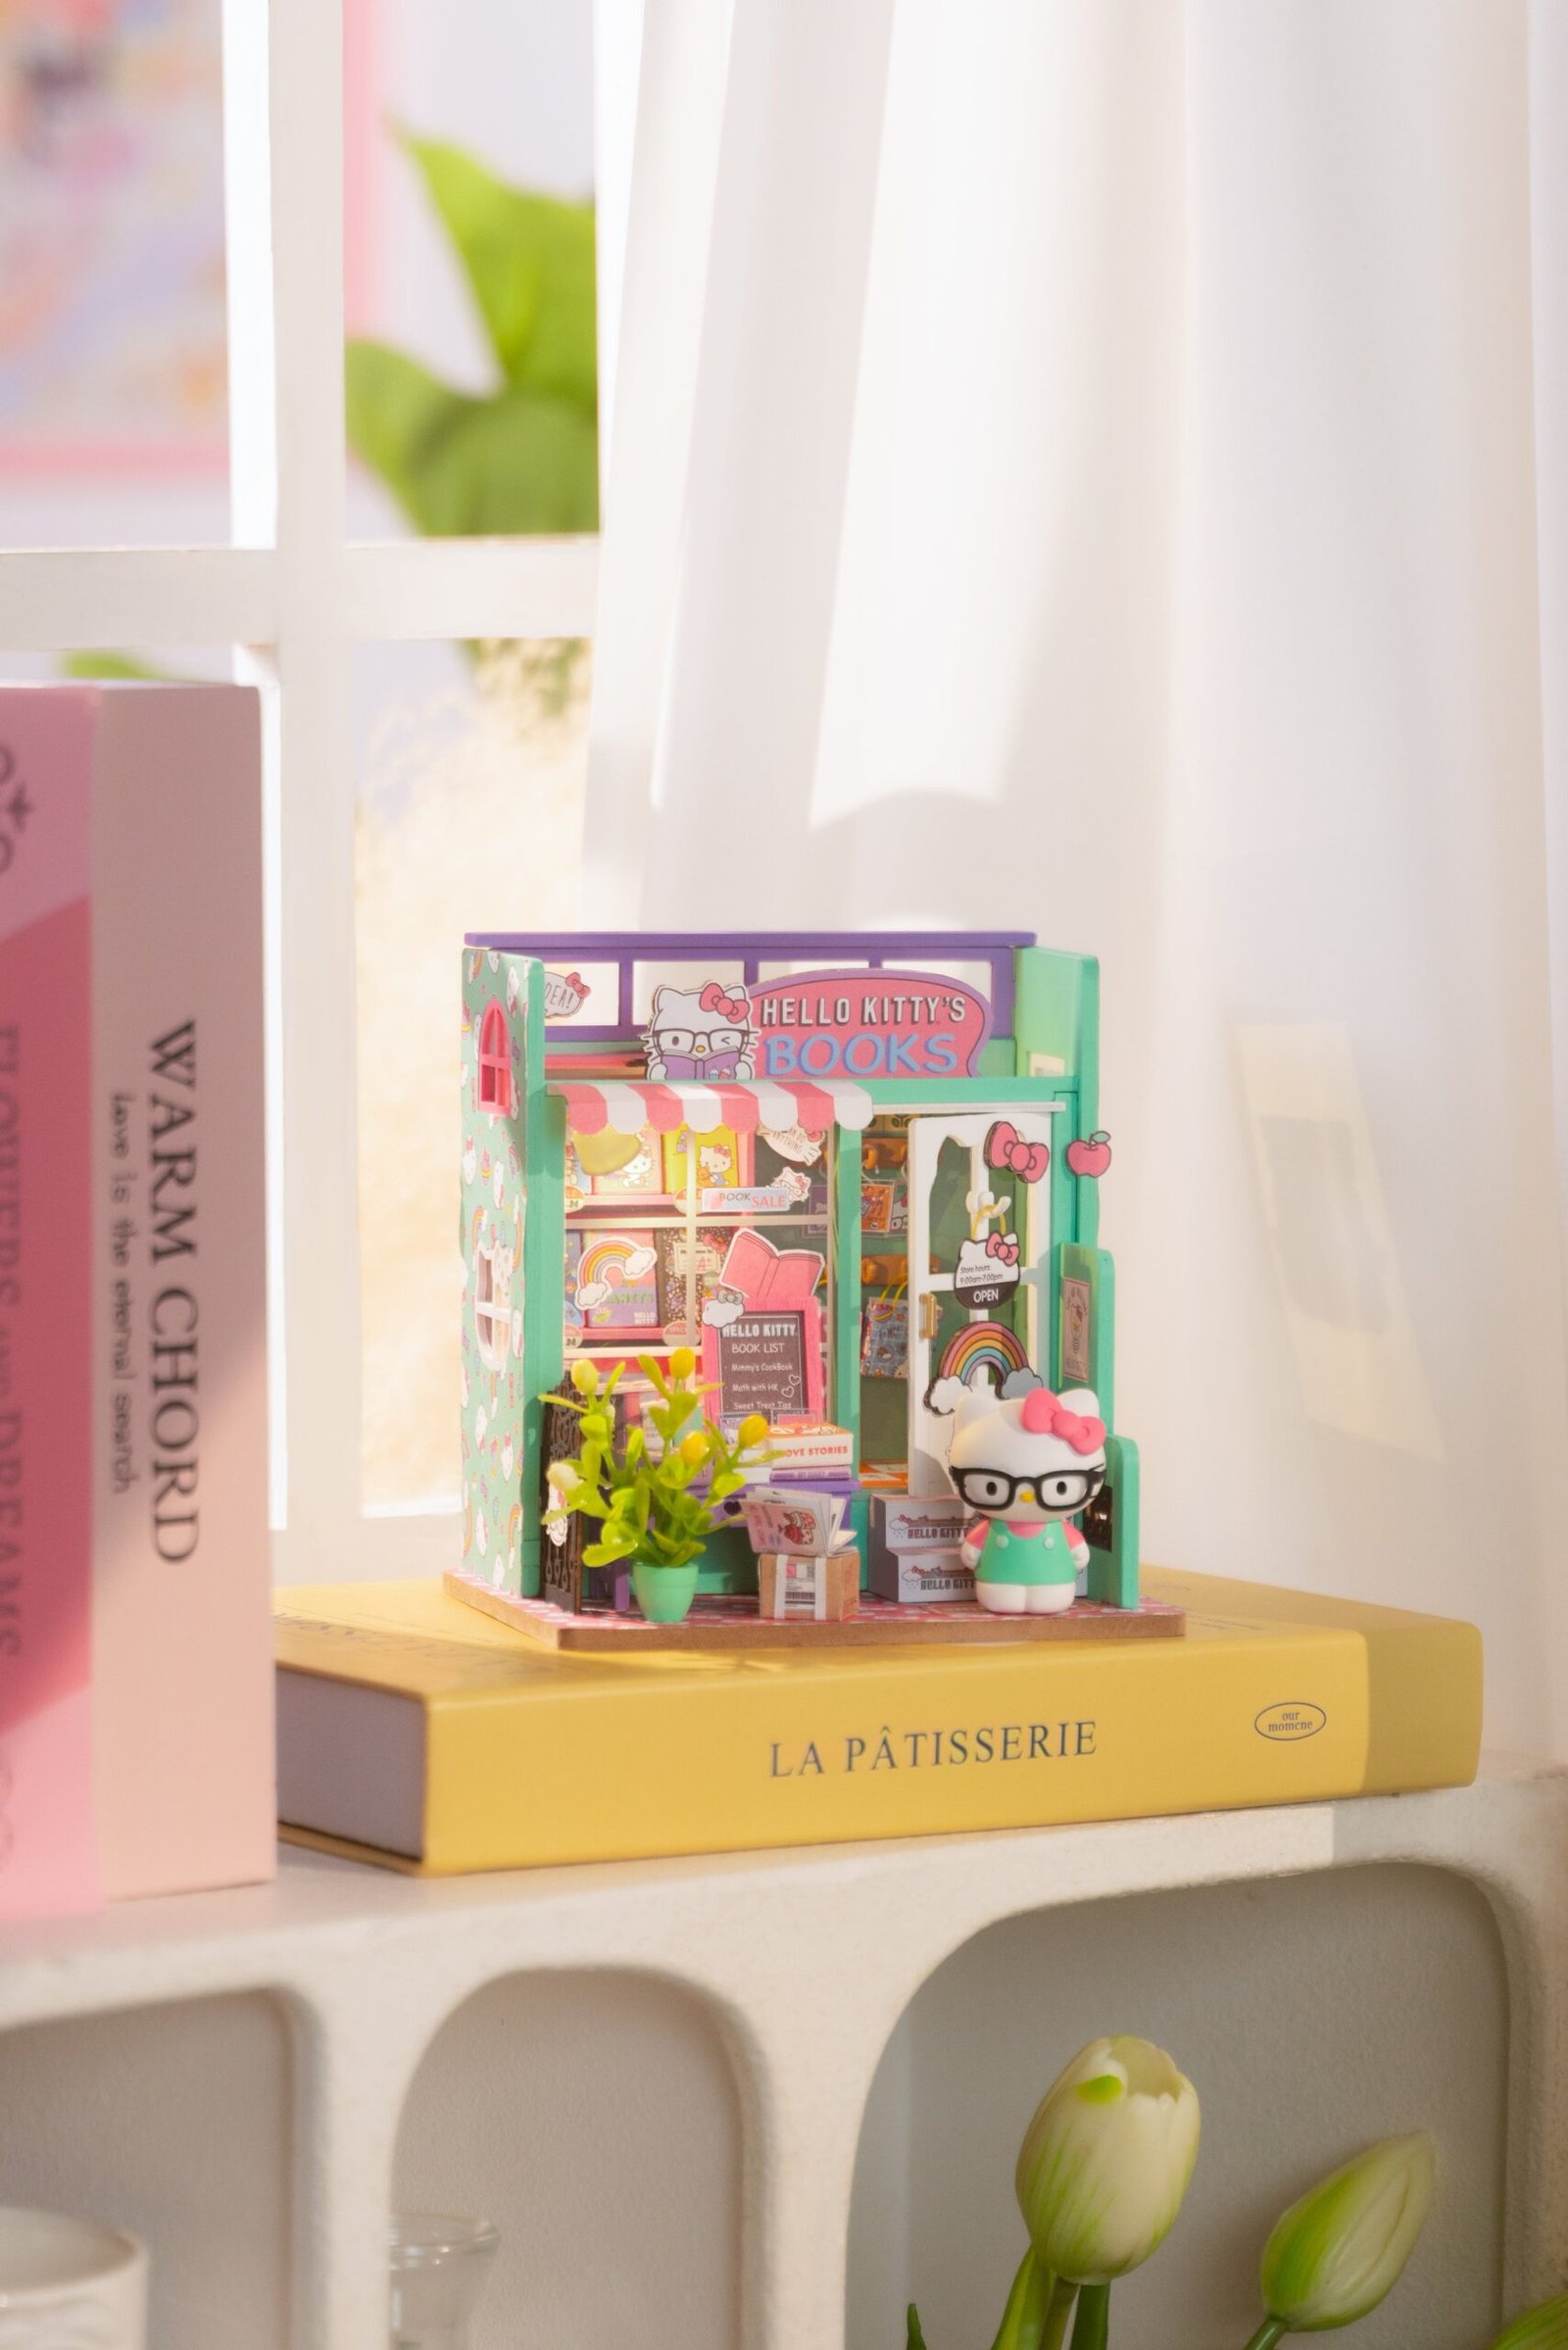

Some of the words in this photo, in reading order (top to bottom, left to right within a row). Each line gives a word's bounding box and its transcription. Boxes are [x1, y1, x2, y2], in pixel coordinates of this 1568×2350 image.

[545, 982, 574, 1009] DEA!
[760, 998, 851, 1027] HELLO
[860, 996, 966, 1026] KITTY'S
[764, 1034, 958, 1076] BOOKS
[150, 1019, 197, 1265] WARM
[719, 1192, 752, 1201] BOOK
[752, 1196, 785, 1208] SALE
[112, 1219, 139, 1266] the
[973, 1289, 999, 1303] OPEN
[722, 1324, 760, 1337] HELLO
[763, 1324, 796, 1337] KITTY
[732, 1344, 761, 1353] BOOK
[764, 1344, 785, 1353] LIST
[752, 1383, 766, 1392] with
[150, 1286, 200, 1563] CHORD
[113, 1393, 140, 1493] search
[786, 1448, 806, 1457] OVE
[808, 1445, 849, 1456] STORIES
[954, 1579, 975, 1590] KITT
[1282, 1712, 1300, 1721] our
[770, 1740, 825, 1778] LA
[846, 1720, 1097, 1773] PÂTISSERIE
